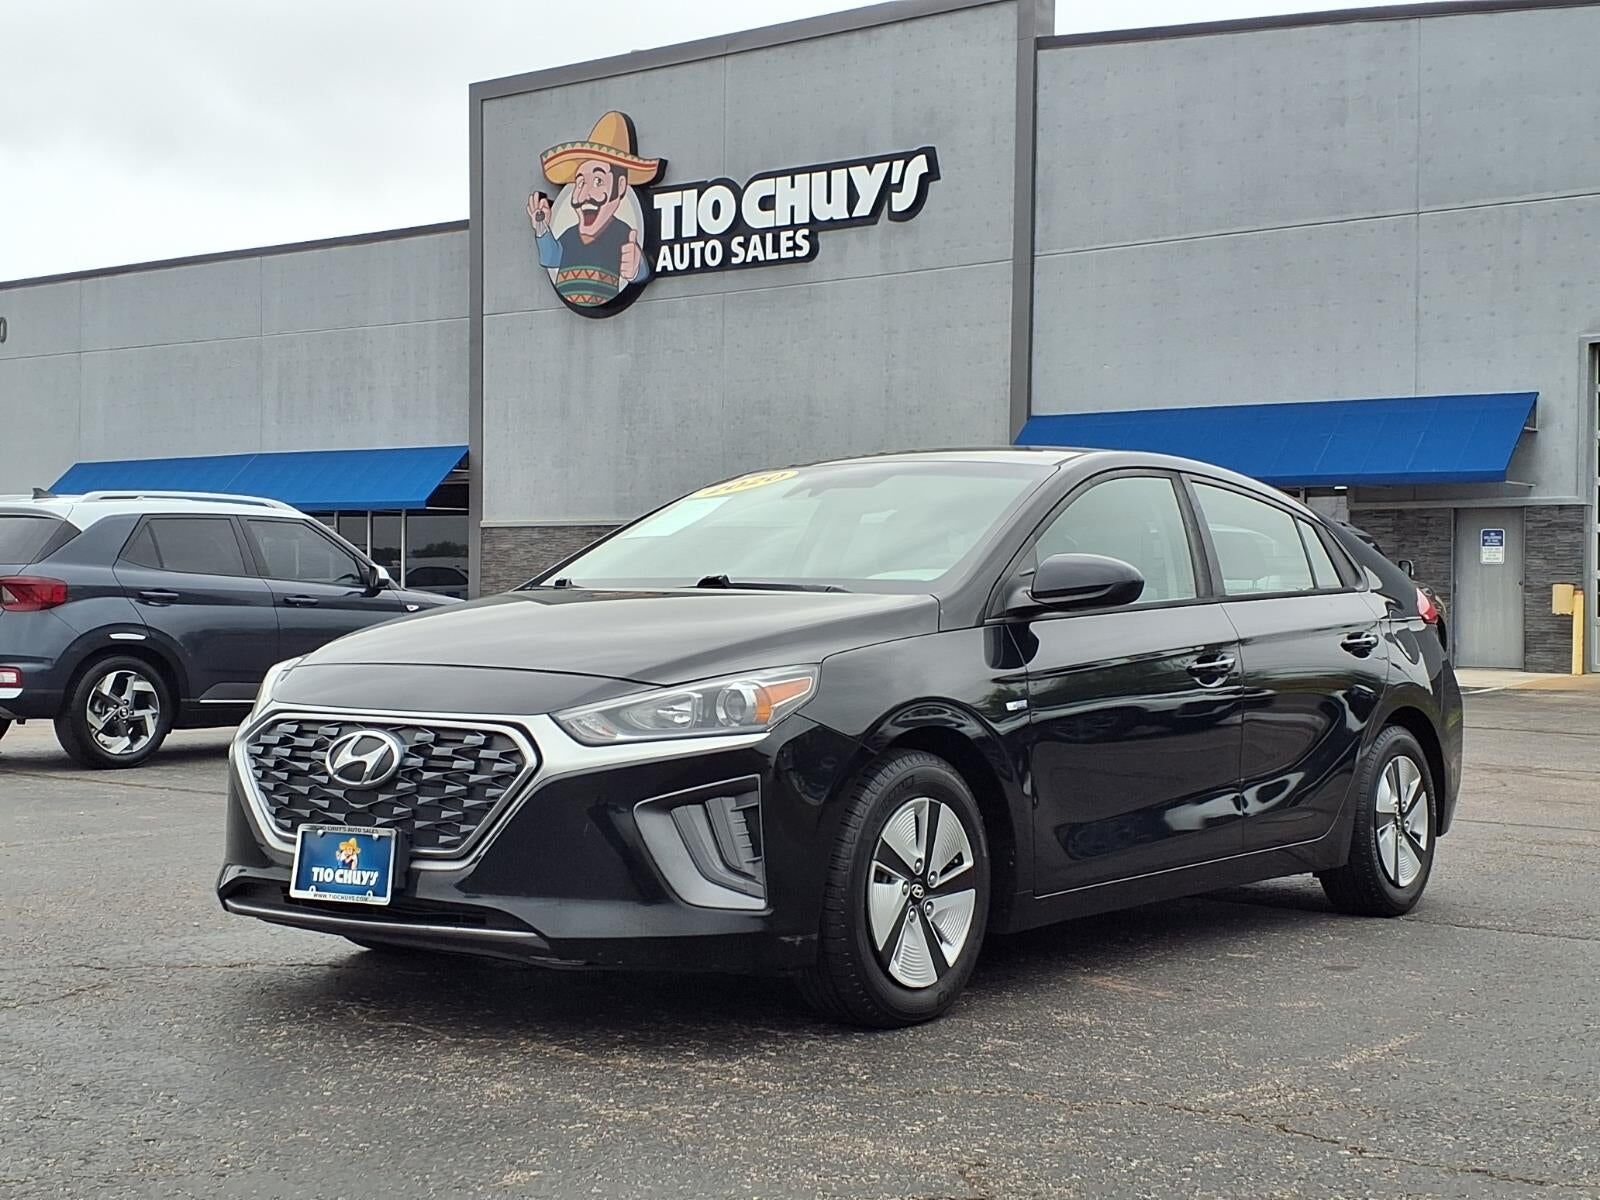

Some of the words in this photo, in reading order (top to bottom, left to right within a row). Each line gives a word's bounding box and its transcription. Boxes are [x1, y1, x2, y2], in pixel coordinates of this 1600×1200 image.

[653, 185, 736, 240] TIO
[741, 154, 929, 229] CHUY'S
[655, 239, 723, 272] AUTO
[731, 229, 811, 264] SALES
[311, 866, 334, 883] TIO
[334, 868, 379, 887] CHUY'S
